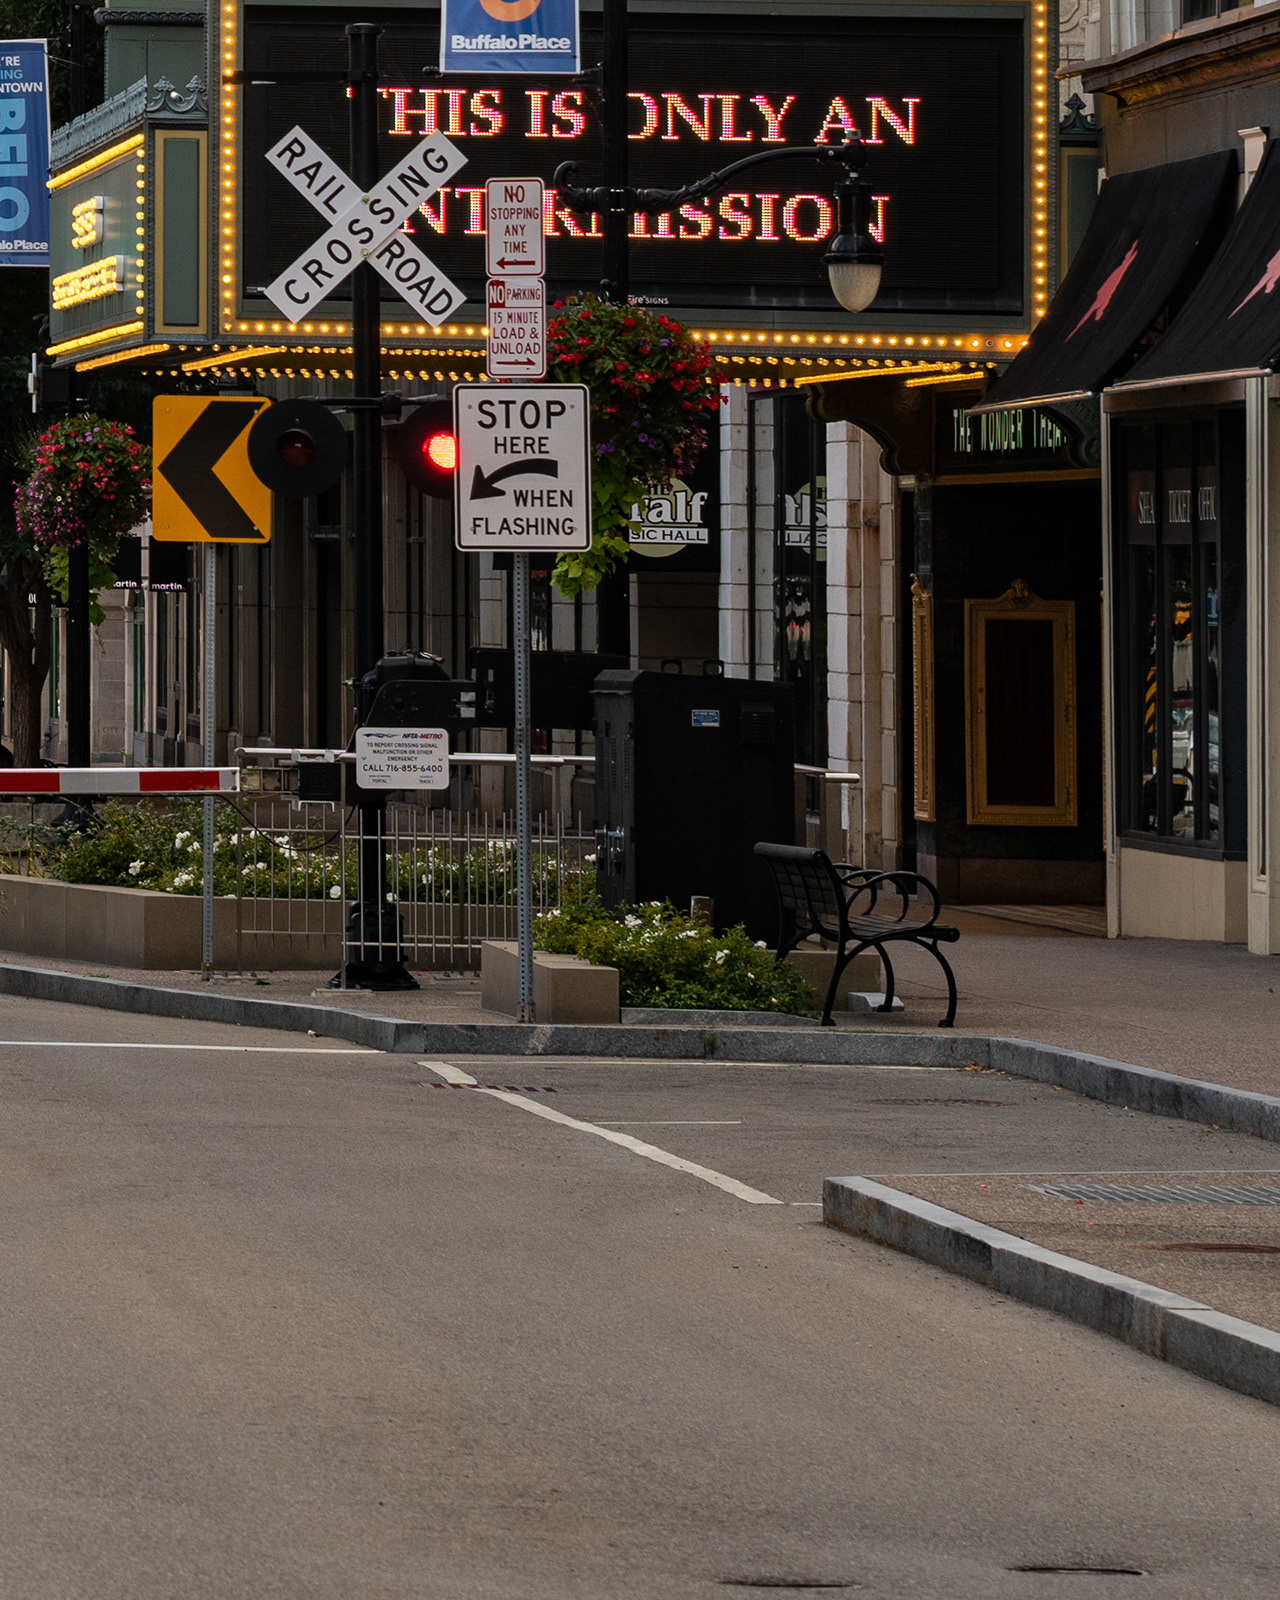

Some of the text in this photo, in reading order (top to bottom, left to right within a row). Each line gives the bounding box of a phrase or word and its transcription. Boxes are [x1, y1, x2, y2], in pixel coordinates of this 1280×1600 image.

[524, 90, 586, 138] IS
[814, 96, 920, 145] AN
[276, 137, 345, 215] RAIL
[504, 185, 525, 203] NO
[490, 207, 539, 220] STOPPING
[284, 148, 449, 305] CROSSING
[504, 225, 526, 237] ANY
[503, 241, 528, 253] TIME
[375, 238, 453, 316] ROAD
[490, 285, 541, 304] NO PARKING
[493, 312, 538, 324] 15 MINUTE
[493, 327, 539, 339] LOAD &
[492, 343, 541, 355] UNLOAD
[477, 399, 566, 429] STOP
[494, 436, 550, 454] HERE
[513, 490, 573, 507] WHEN
[472, 517, 574, 536] FLASHING
[662, 530, 706, 542] HALL
[363, 764, 443, 772] CALL 716-855-6400
